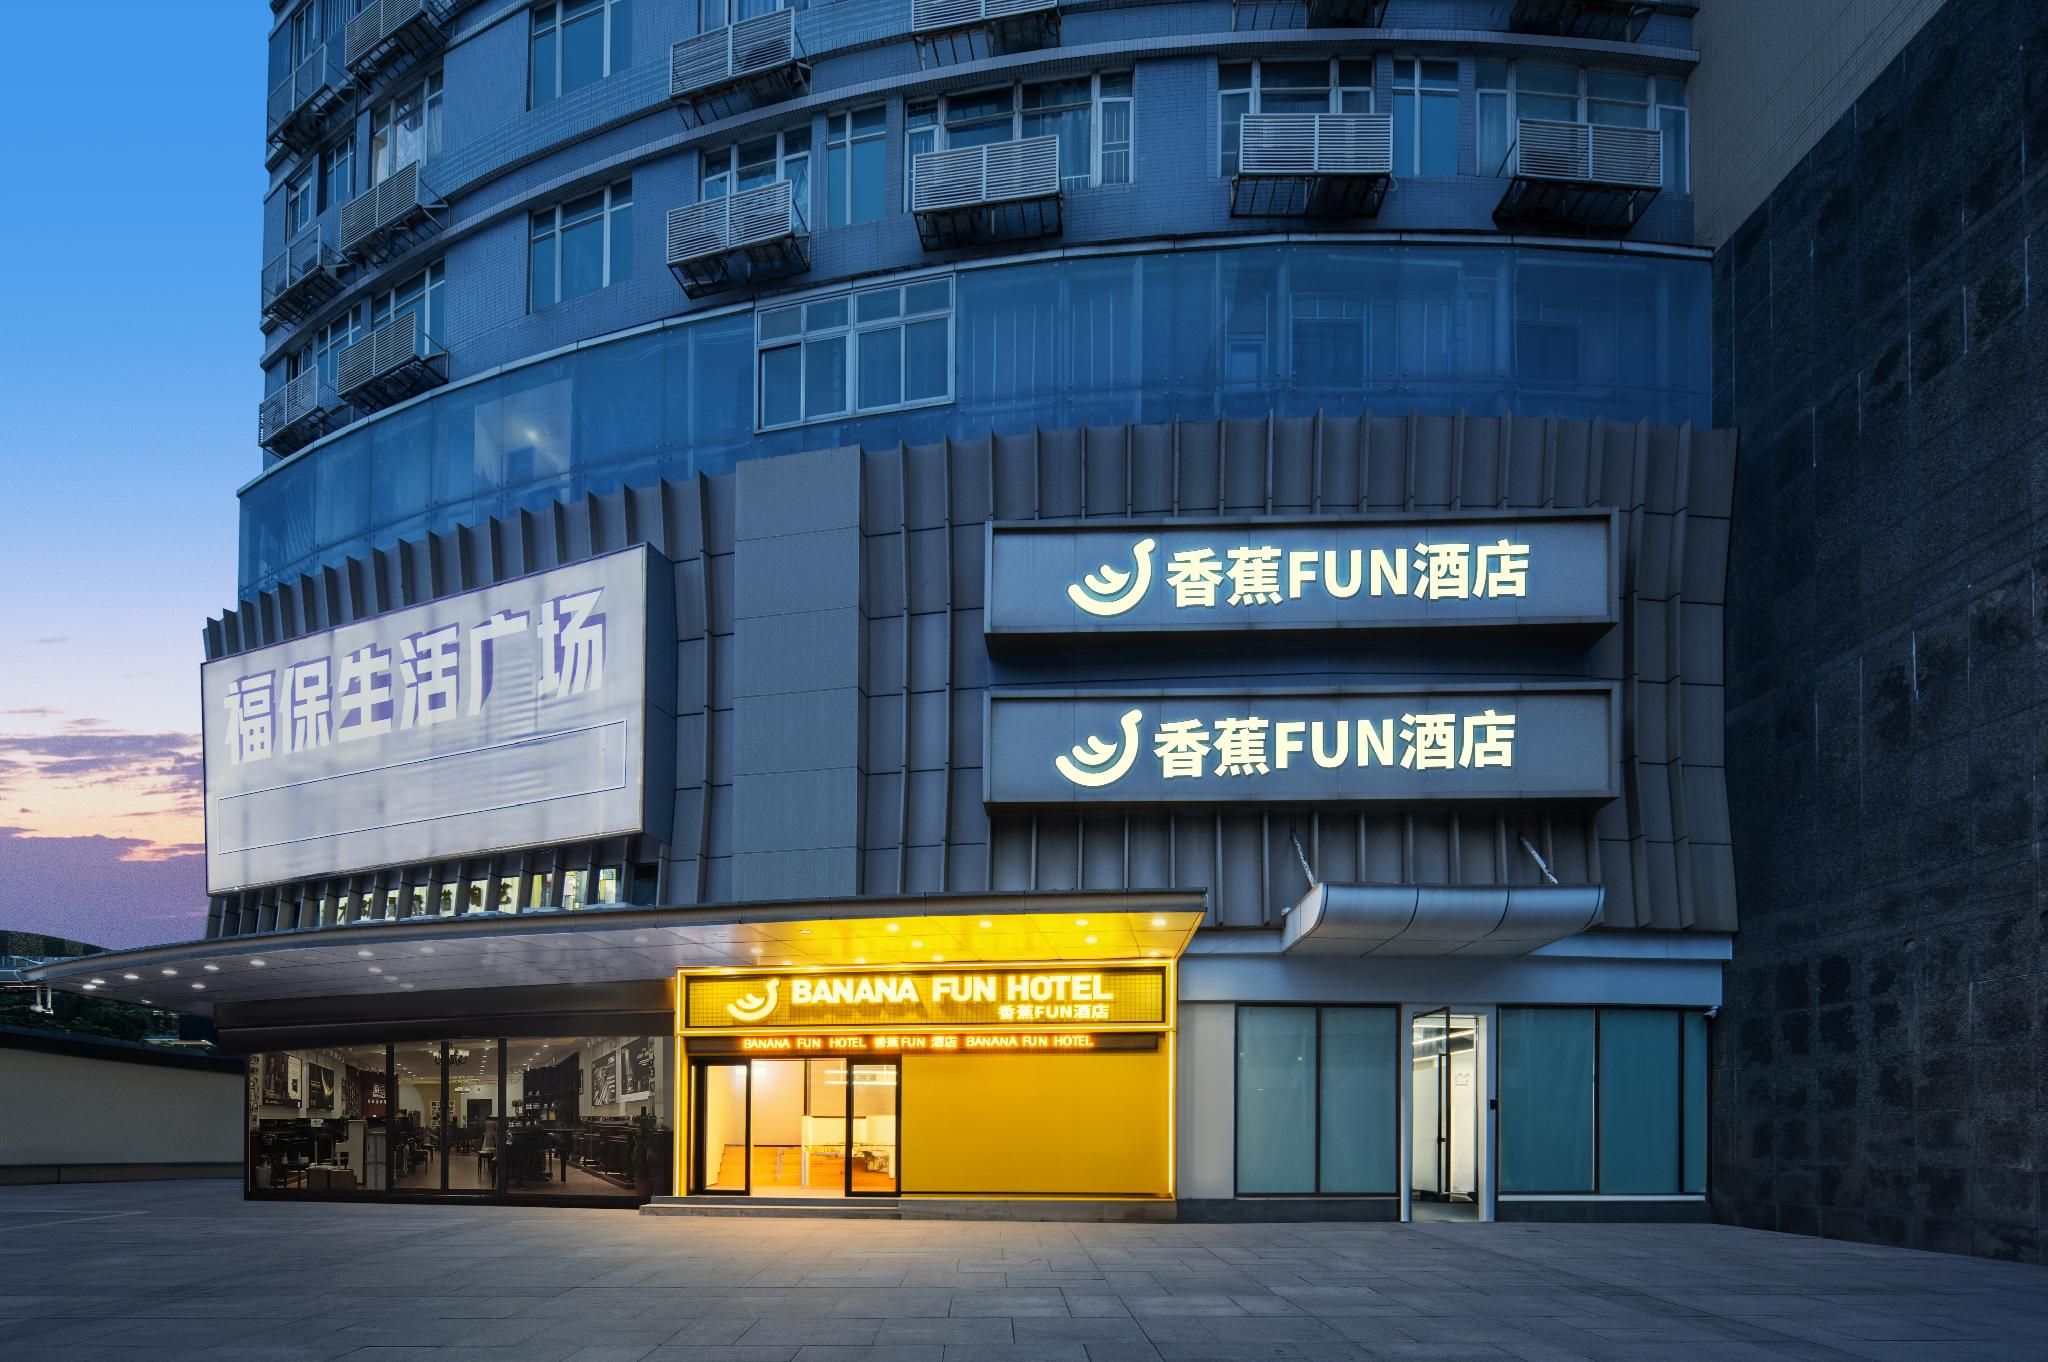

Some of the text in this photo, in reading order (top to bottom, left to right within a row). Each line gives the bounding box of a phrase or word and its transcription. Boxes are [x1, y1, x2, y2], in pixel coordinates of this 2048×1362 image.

[1166, 539, 1530, 609] 香蕉FUN酒店
[222, 586, 607, 766] 福保生活广场
[1154, 709, 1517, 779] 香蕉FUN酒店
[791, 974, 1113, 1003] BANANA FUN HOTEL
[998, 1005, 1109, 1020] 香蕉FUN酒店
[743, 1038, 790, 1049] BANANA
[797, 1038, 821, 1049] FUN
[829, 1037, 866, 1048] HOTEL
[966, 1036, 1017, 1047] BANANA
[1022, 1036, 1048, 1047] FUN
[1054, 1036, 1094, 1047] HOTEL
